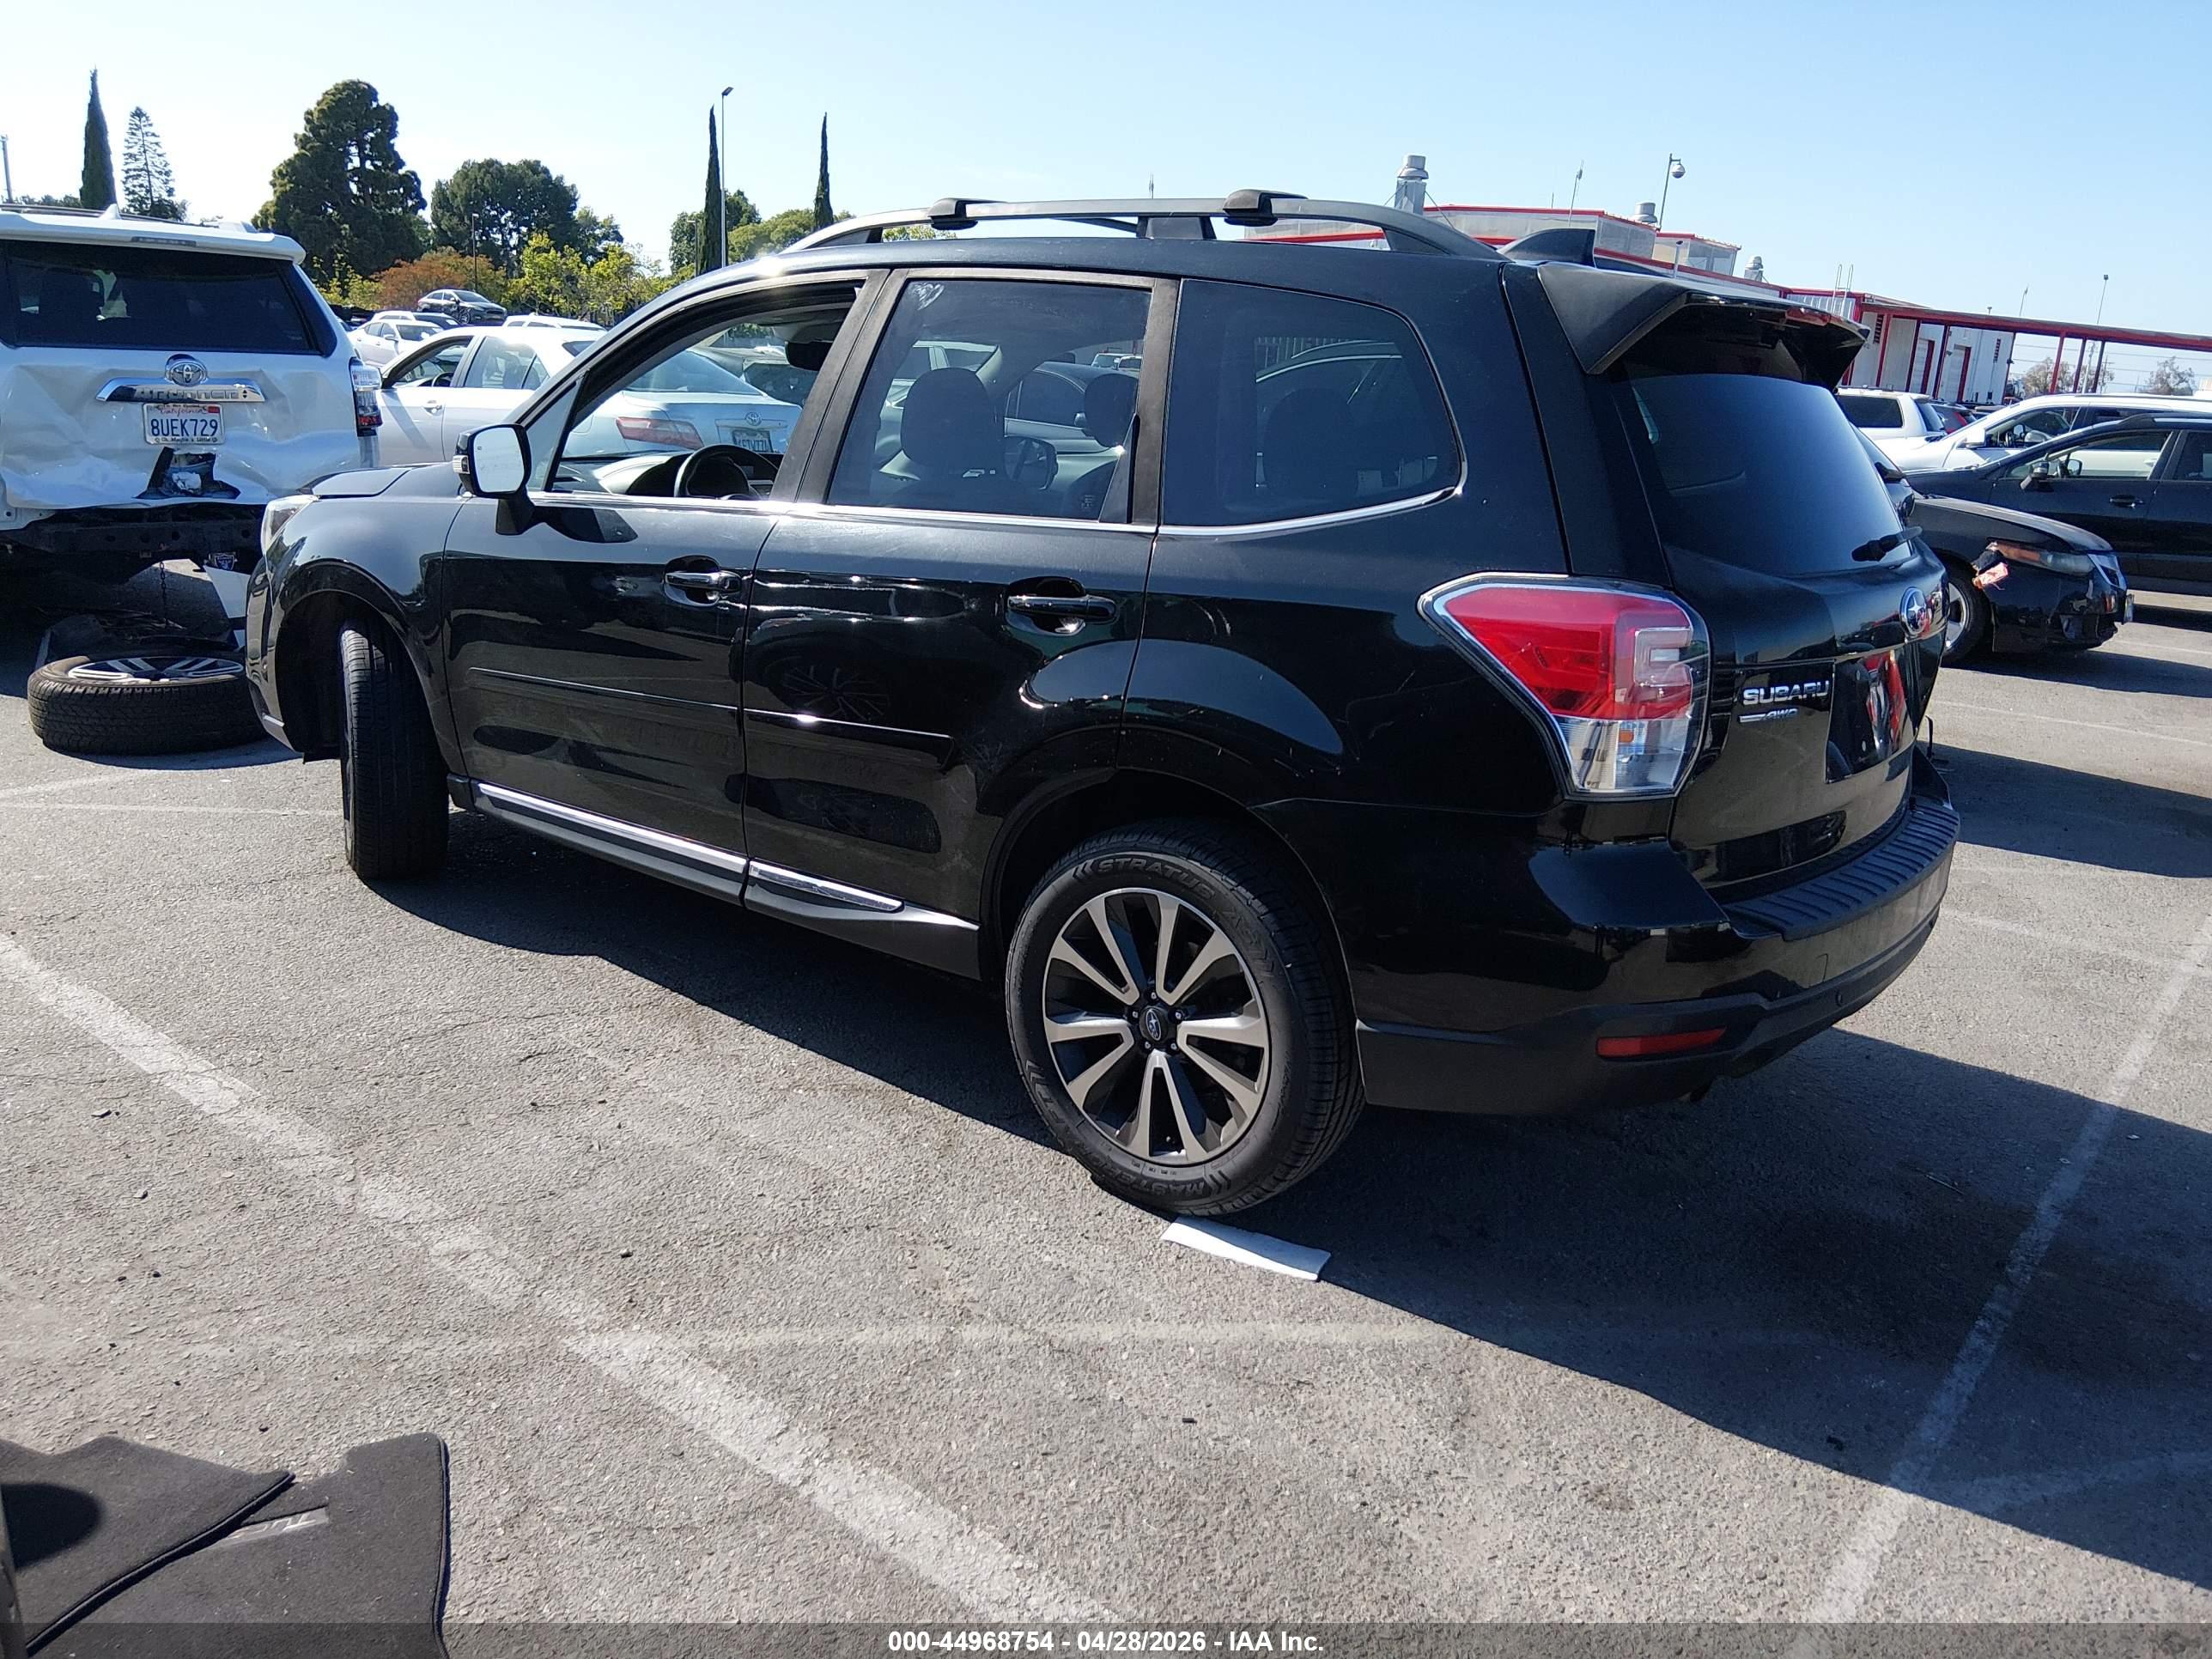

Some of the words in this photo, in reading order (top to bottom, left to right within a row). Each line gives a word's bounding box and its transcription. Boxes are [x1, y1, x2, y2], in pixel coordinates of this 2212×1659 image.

[150, 418, 218, 437] 8UEK729
[1743, 681, 1829, 705] SUBARU
[1097, 857, 1218, 901] STRATUS
